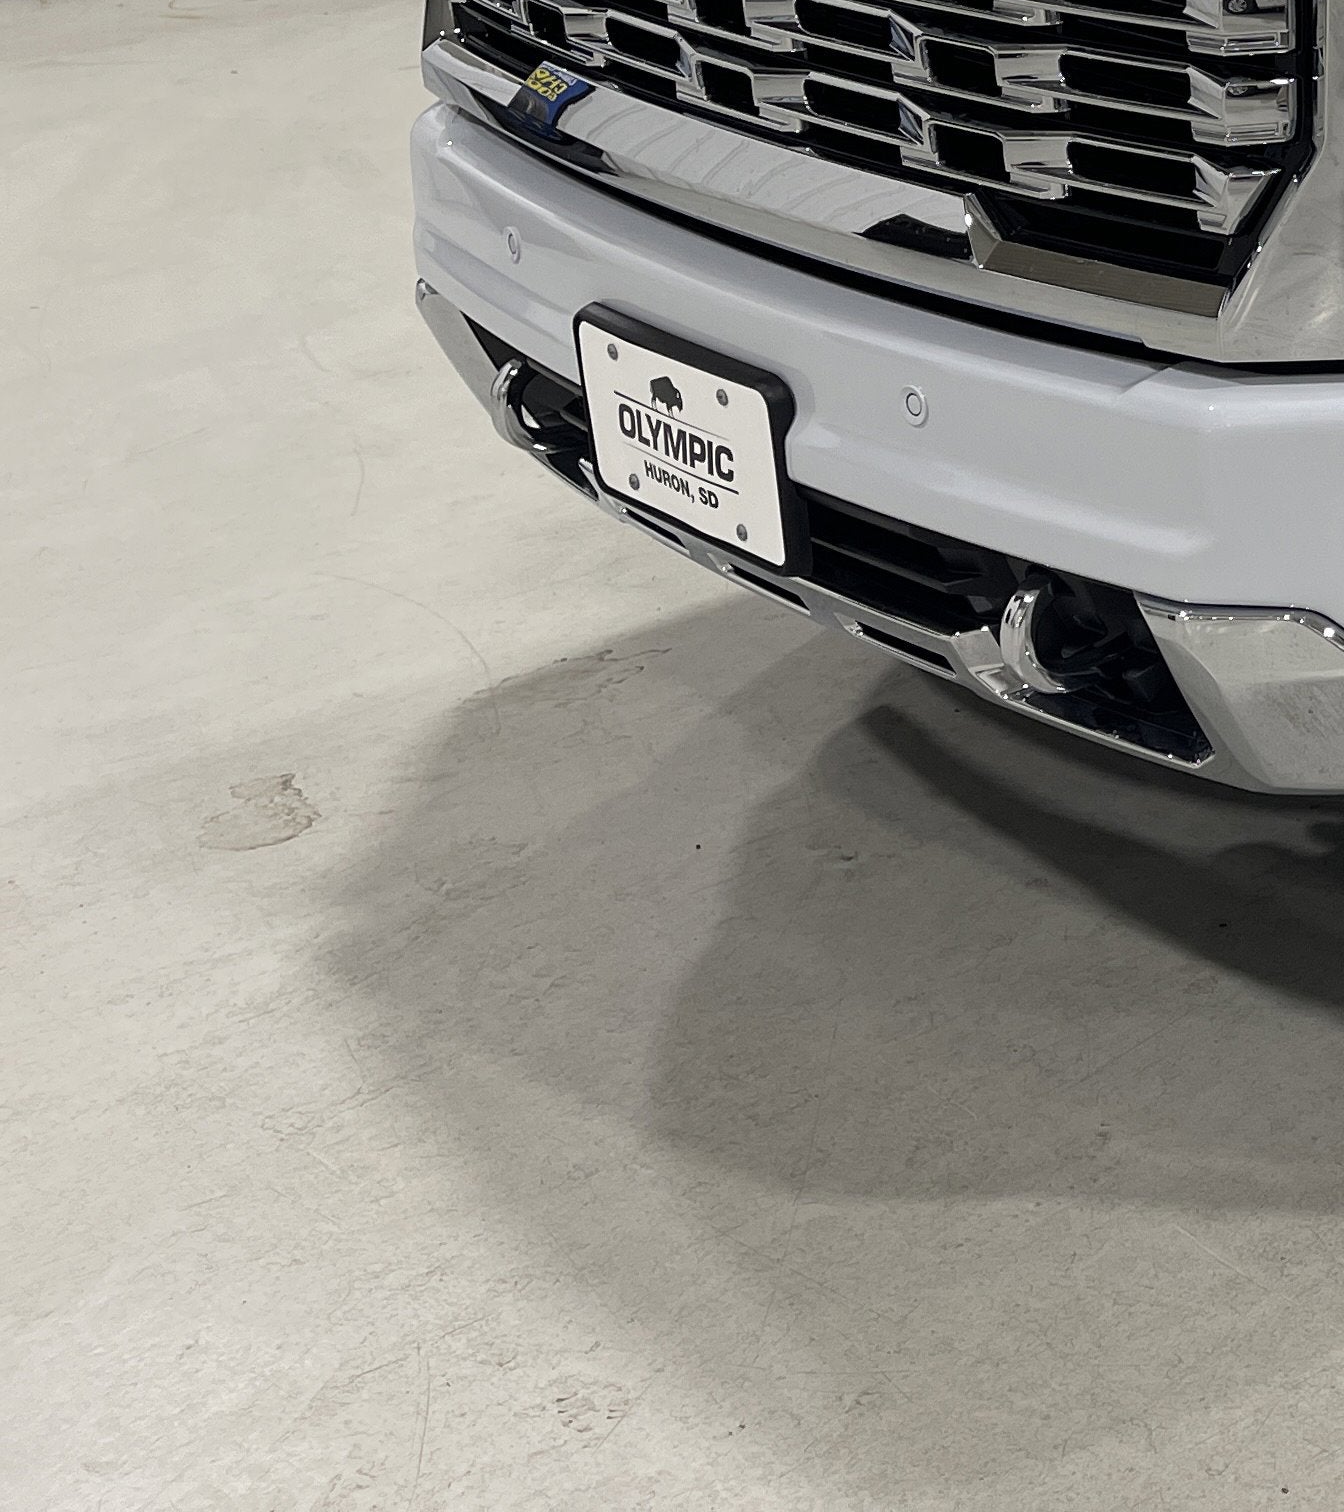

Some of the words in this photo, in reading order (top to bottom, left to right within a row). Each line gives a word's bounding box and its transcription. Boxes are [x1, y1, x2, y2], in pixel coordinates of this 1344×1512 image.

[618, 403, 734, 483] OLYMPIC
[643, 459, 695, 504] HURON,
[699, 486, 719, 509] SD
